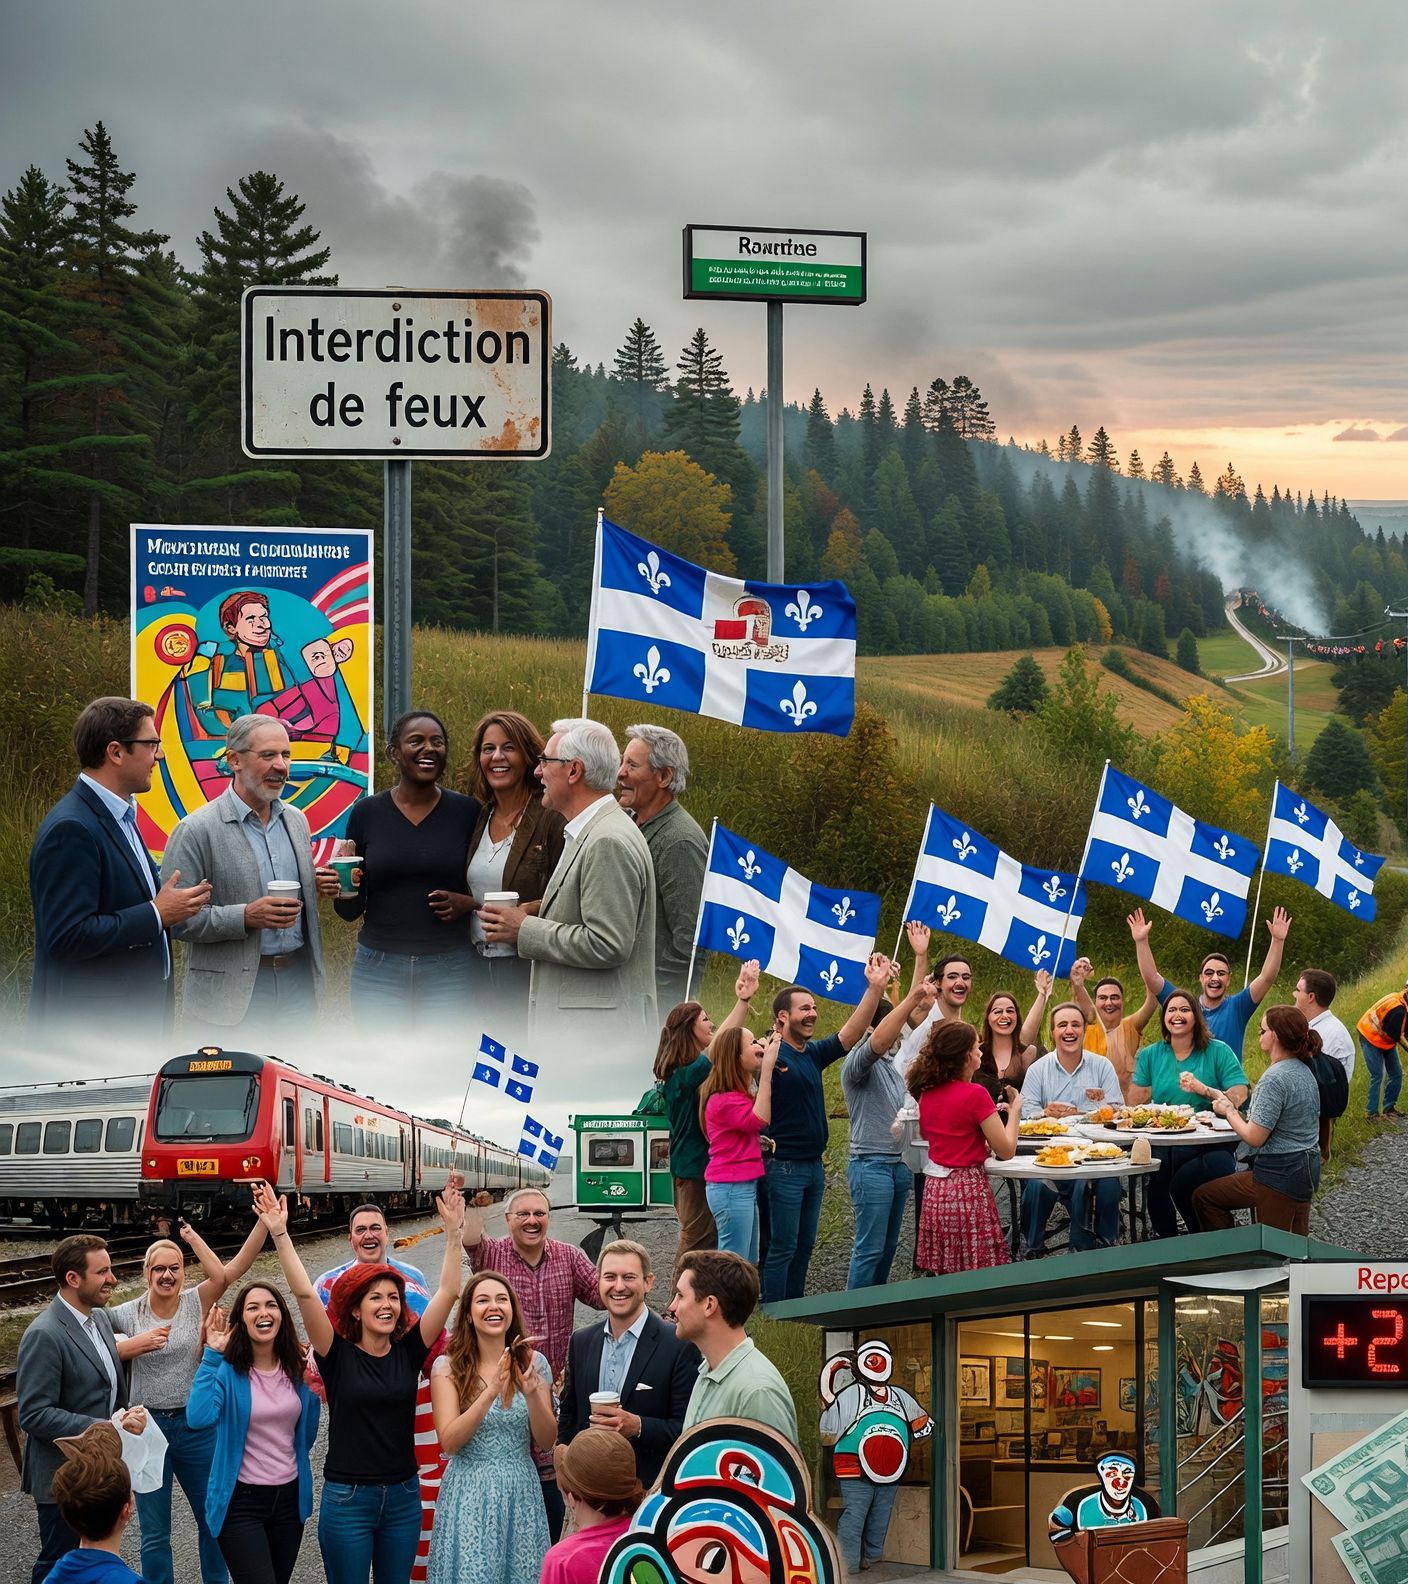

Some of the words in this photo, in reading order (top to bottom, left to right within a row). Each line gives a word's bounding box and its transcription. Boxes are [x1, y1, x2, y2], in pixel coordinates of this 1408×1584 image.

[265, 315, 531, 365] Interdiction
[309, 381, 365, 428] de
[385, 381, 488, 429] feux
